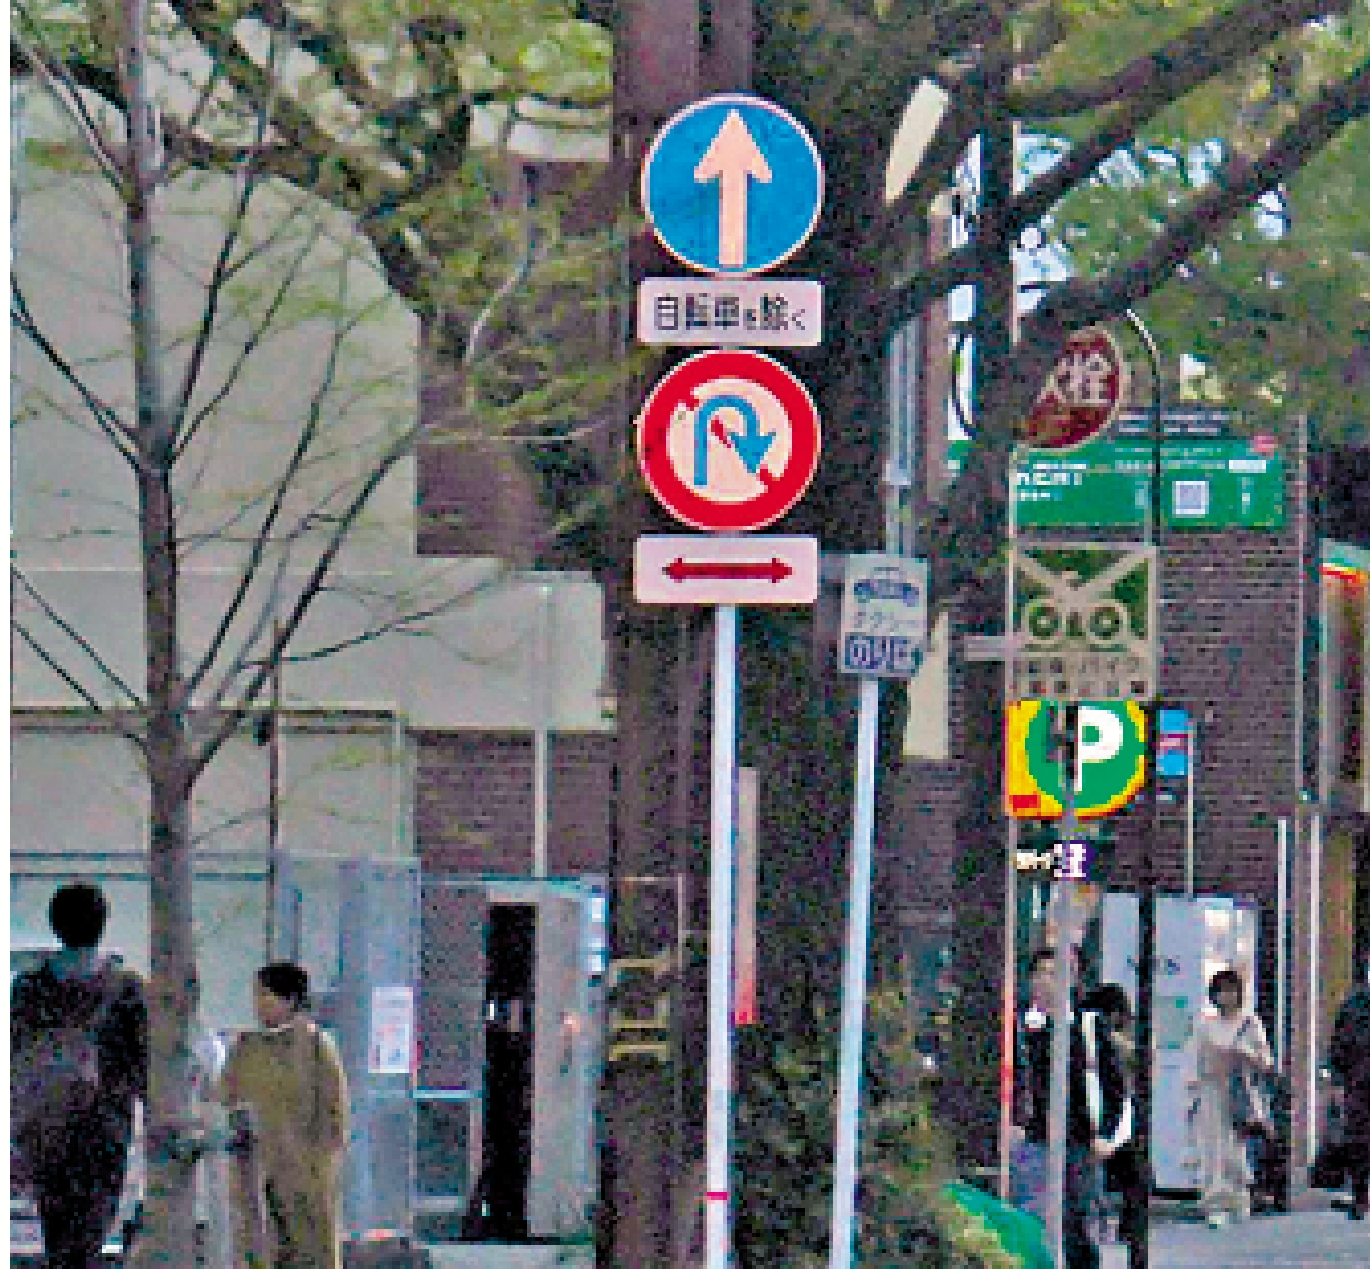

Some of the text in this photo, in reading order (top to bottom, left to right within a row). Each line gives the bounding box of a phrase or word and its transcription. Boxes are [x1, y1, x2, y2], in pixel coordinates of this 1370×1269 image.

[655, 293, 806, 331] 自転車を除く
[1074, 706, 1124, 794] P
